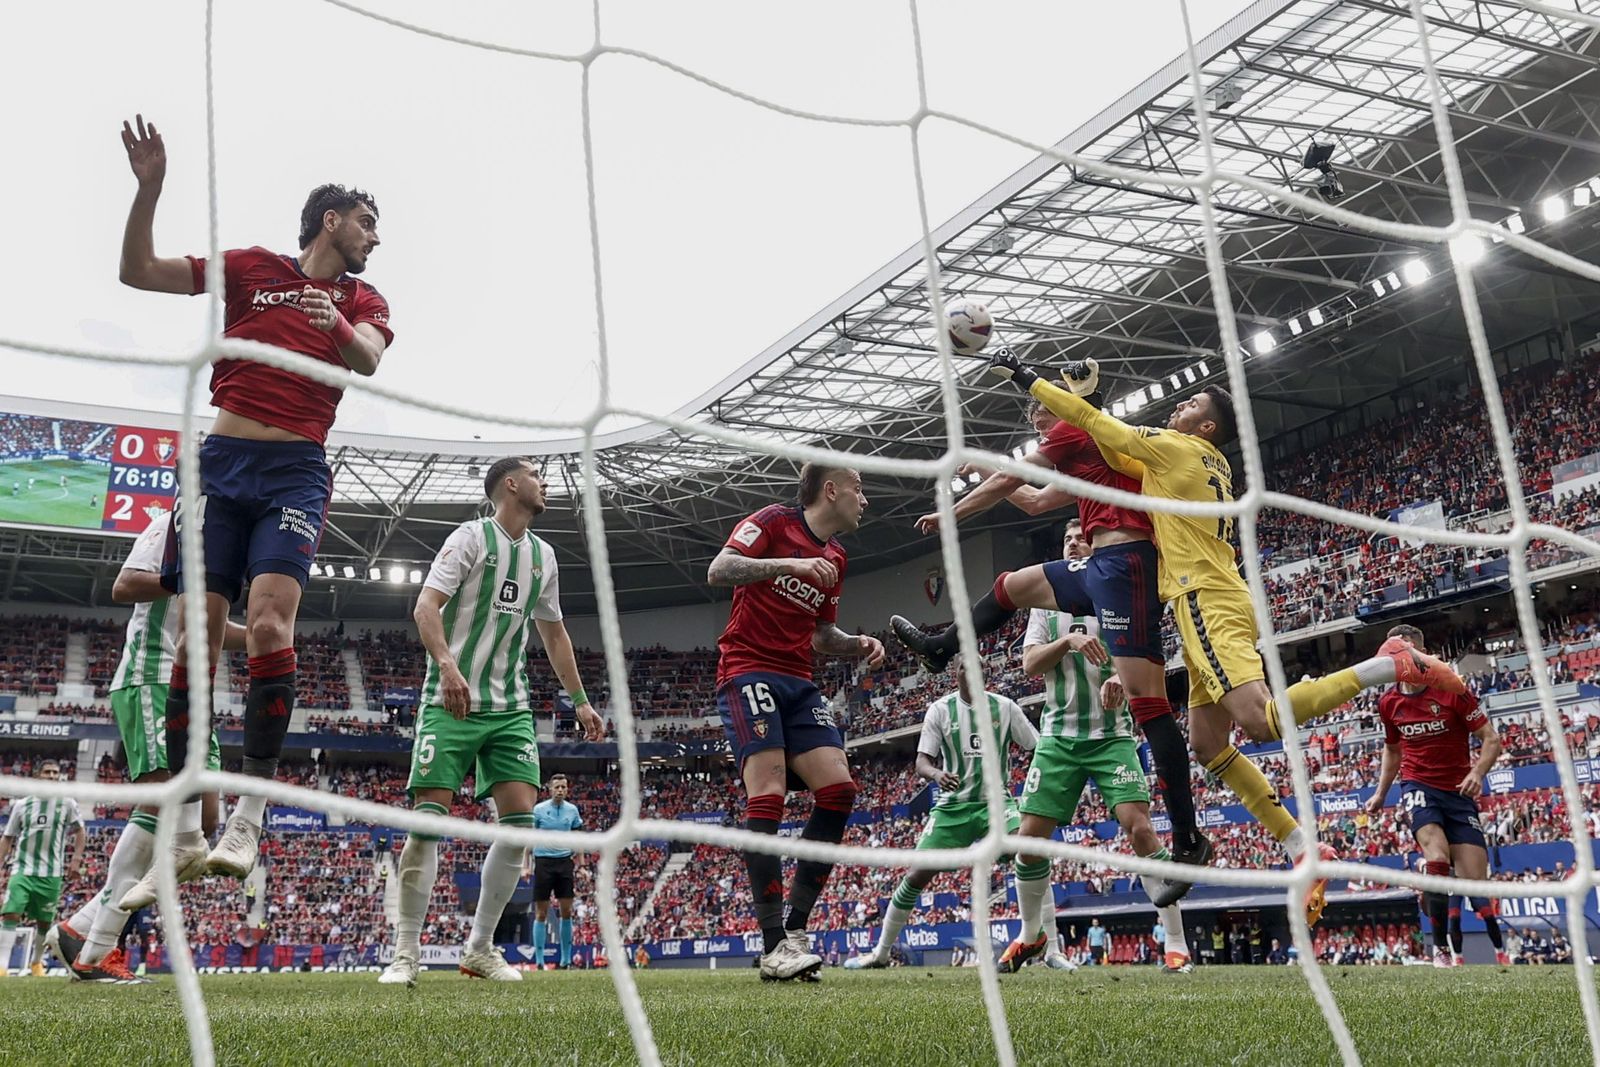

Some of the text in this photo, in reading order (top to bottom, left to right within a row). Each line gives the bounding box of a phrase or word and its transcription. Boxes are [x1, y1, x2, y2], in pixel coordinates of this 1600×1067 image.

[120, 434, 144, 459] 0
[114, 466, 174, 489] 76:19
[111, 494, 134, 520] 2
[279, 521, 289, 530] de
[741, 682, 776, 716] 15
[13, 723, 29, 735] SE
[31, 724, 70, 736] RINDE
[418, 734, 437, 764] 5
[1320, 797, 1358, 812] Noticias
[1403, 789, 1427, 812] 34
